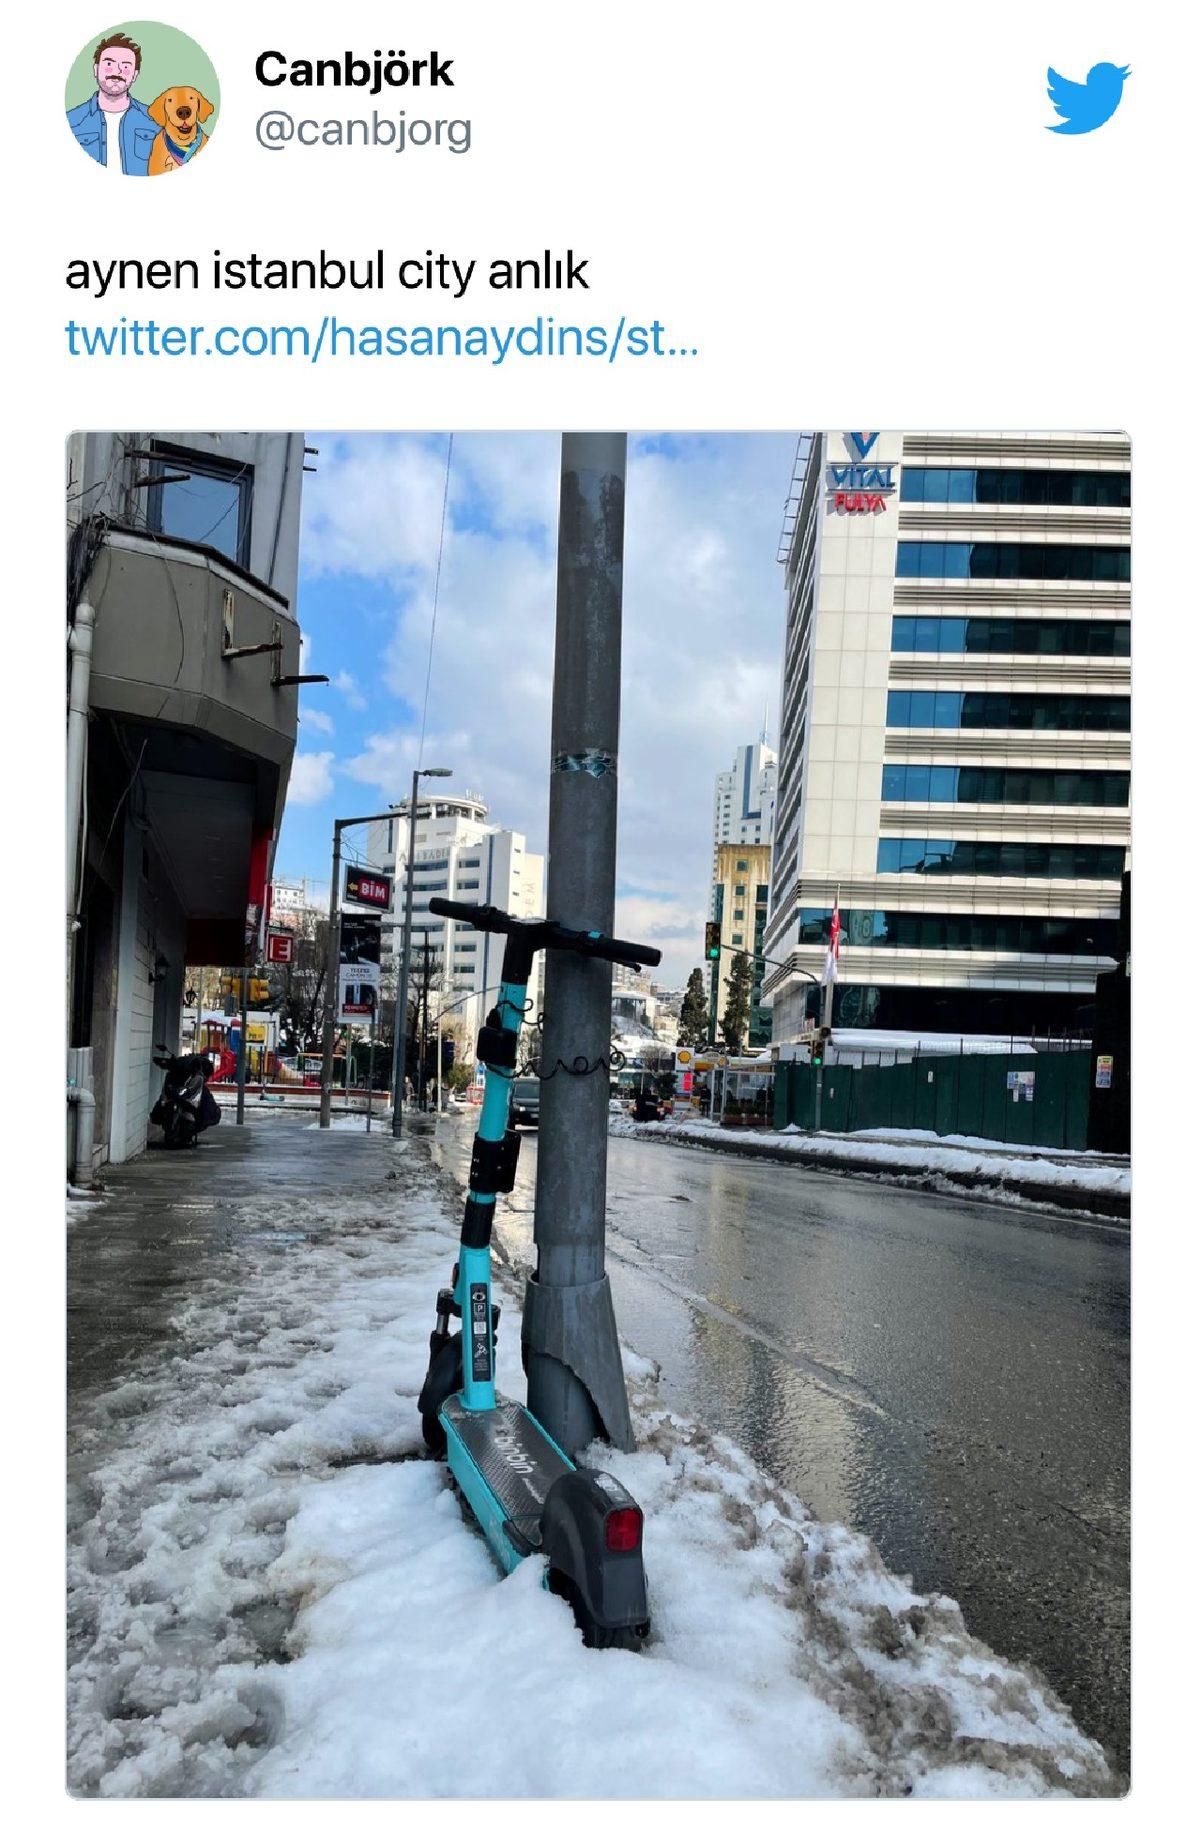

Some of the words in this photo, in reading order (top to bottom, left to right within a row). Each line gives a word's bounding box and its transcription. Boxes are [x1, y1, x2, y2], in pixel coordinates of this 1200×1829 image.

[831, 465, 896, 488] VITAL
[835, 492, 887, 513] FULYA
[361, 880, 386, 899] BİM
[272, 938, 288, 960] E
